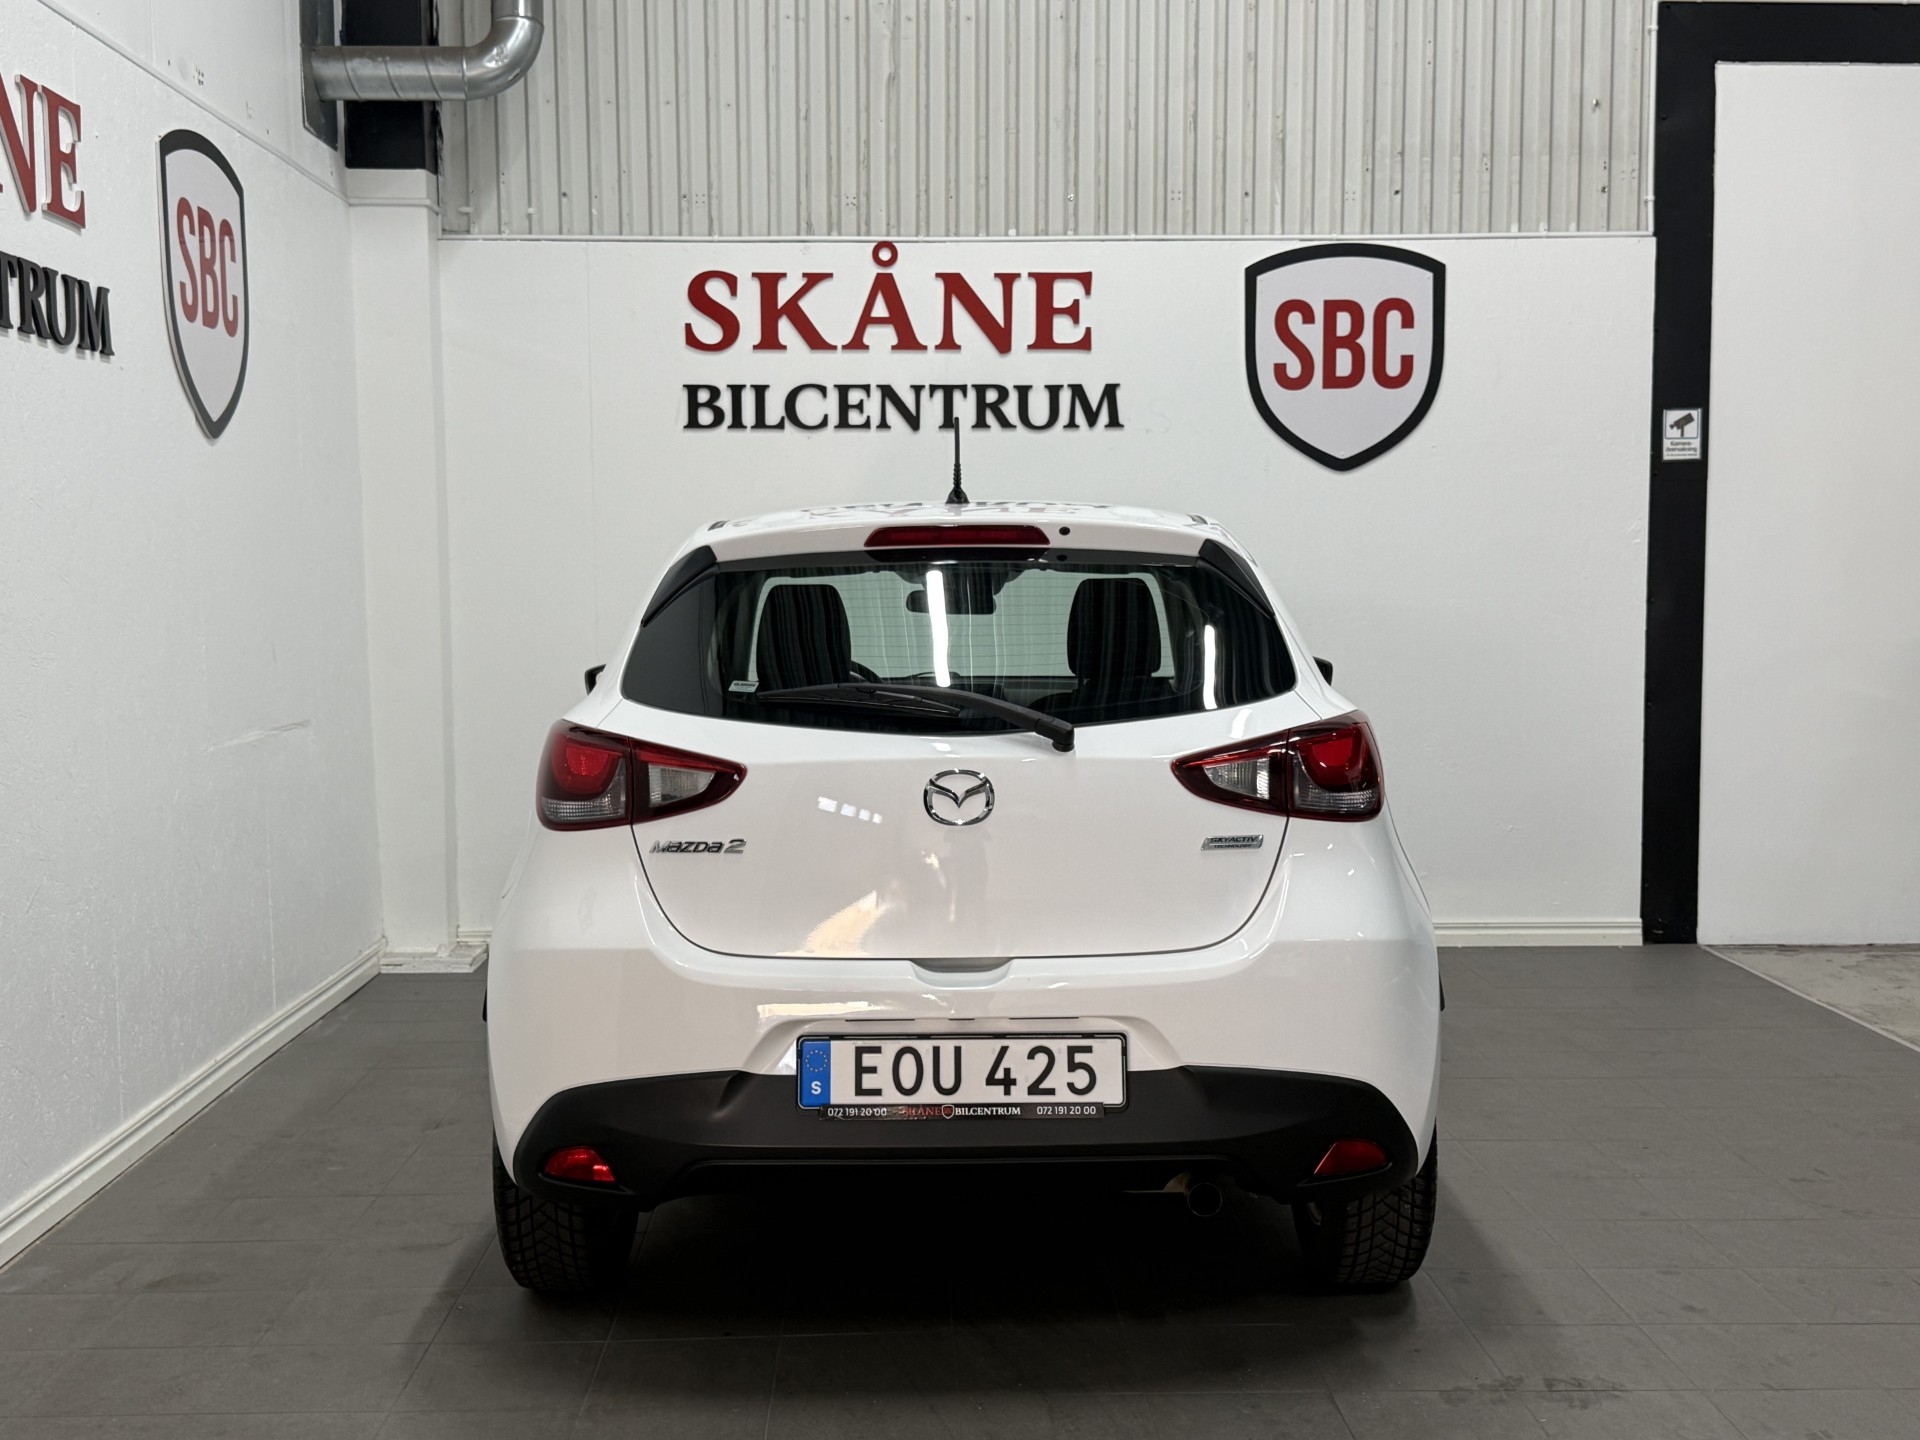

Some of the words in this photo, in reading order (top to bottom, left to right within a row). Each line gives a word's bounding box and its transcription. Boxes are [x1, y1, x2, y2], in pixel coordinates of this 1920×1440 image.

[0, 73, 86, 228] NE
[177, 196, 239, 338] SBC
[684, 241, 1094, 353] SKÅNE
[1272, 297, 1416, 391] SBC
[682, 383, 1125, 430] BILCENTRUM
[810, 1081, 822, 1095] S
[854, 1045, 962, 1096] EOU
[985, 1045, 1097, 1096] 425
[827, 1108, 843, 1116] 072
[955, 1107, 1021, 1115] BILCENTRUM
[1036, 1106, 1052, 1115] 072
[1055, 1106, 1067, 1115] 191
[1070, 1106, 1082, 1115] 20
[1084, 1106, 1097, 1115] 00
